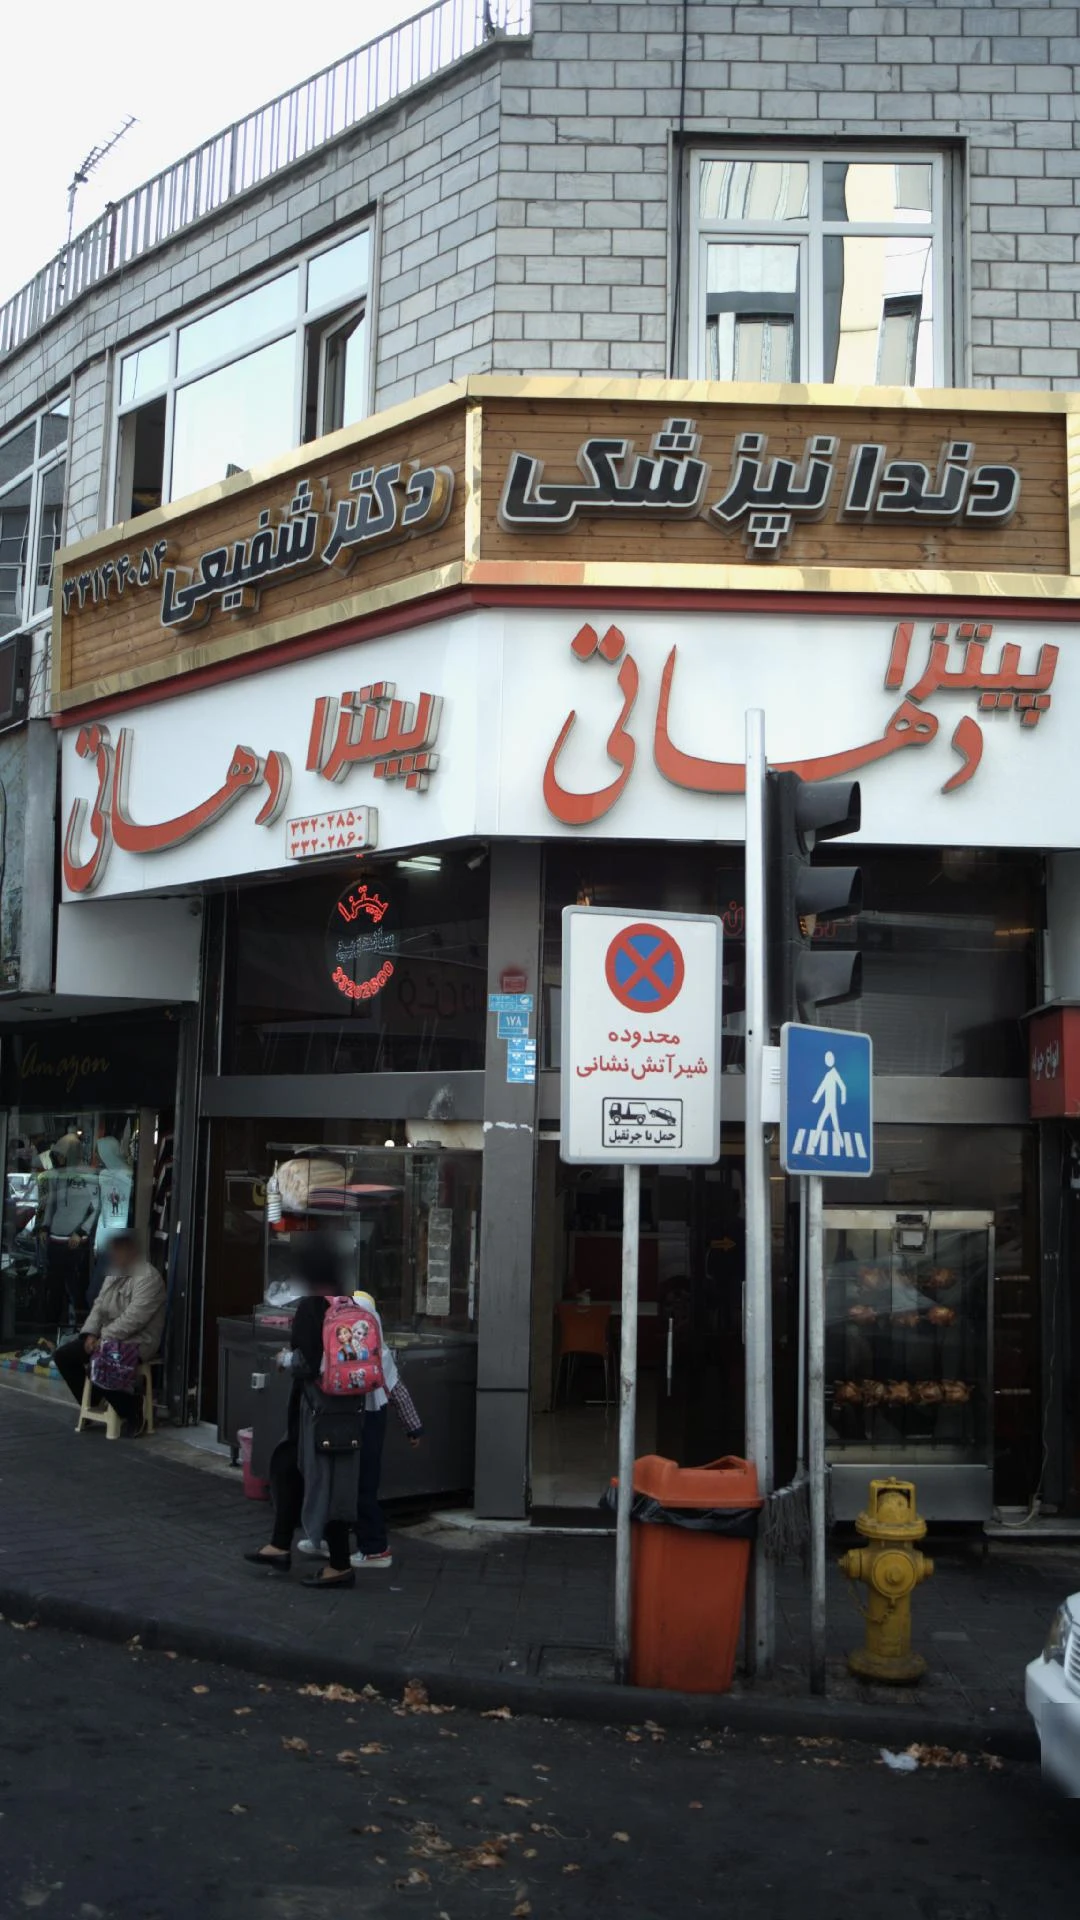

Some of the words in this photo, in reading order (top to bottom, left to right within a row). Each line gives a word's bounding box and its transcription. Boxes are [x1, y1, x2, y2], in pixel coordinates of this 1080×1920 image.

[321, 462, 442, 566] دکتر
[160, 480, 319, 628] شفیعی
[62, 539, 168, 616] ۳۳۱۴۴۰۵۴
[884, 621, 1061, 728] پیتزا
[305, 681, 444, 792] پیتزا
[542, 621, 985, 826] دهاتی
[63, 723, 292, 894] دهاتی
[290, 810, 363, 837] ۳۳۲۰۲۸۵۰
[290, 831, 364, 857] ۳۳۲۰۲۸۶۰
[505, 1014, 522, 1027] ۱۷۸
[608, 1029, 681, 1050] محدوده
[576, 1055, 630, 1079] نشانی
[630, 1053, 676, 1081] آتش
[674, 1055, 709, 1080] شیر
[608, 1128, 643, 1145] جرثقیل
[653, 1129, 677, 1144] حمل
